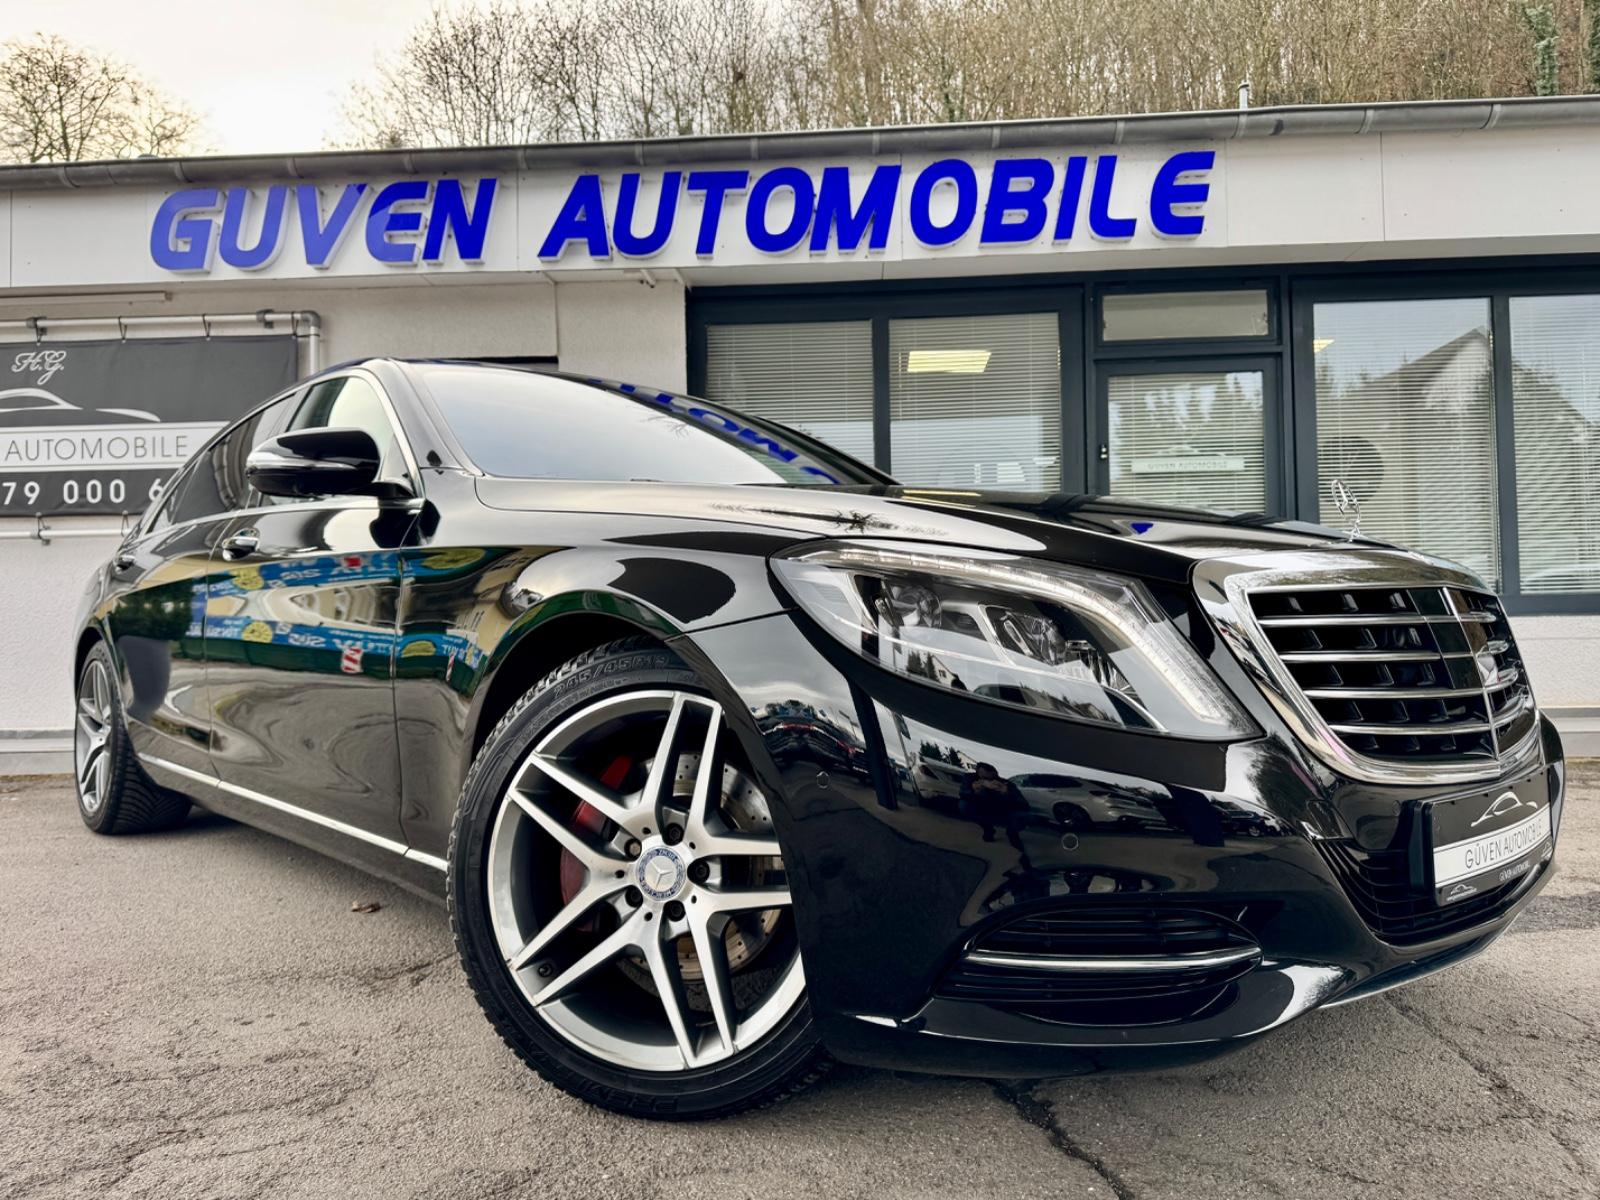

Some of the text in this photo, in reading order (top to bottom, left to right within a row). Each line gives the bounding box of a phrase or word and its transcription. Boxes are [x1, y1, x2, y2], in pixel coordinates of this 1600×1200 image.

[150, 150, 1216, 270] GUVEN AUTOMOBILE
[4, 435, 188, 461] AUTOMOBILE
[63, 479, 125, 504] 000
[1465, 841, 1502, 869] GÜVEN
